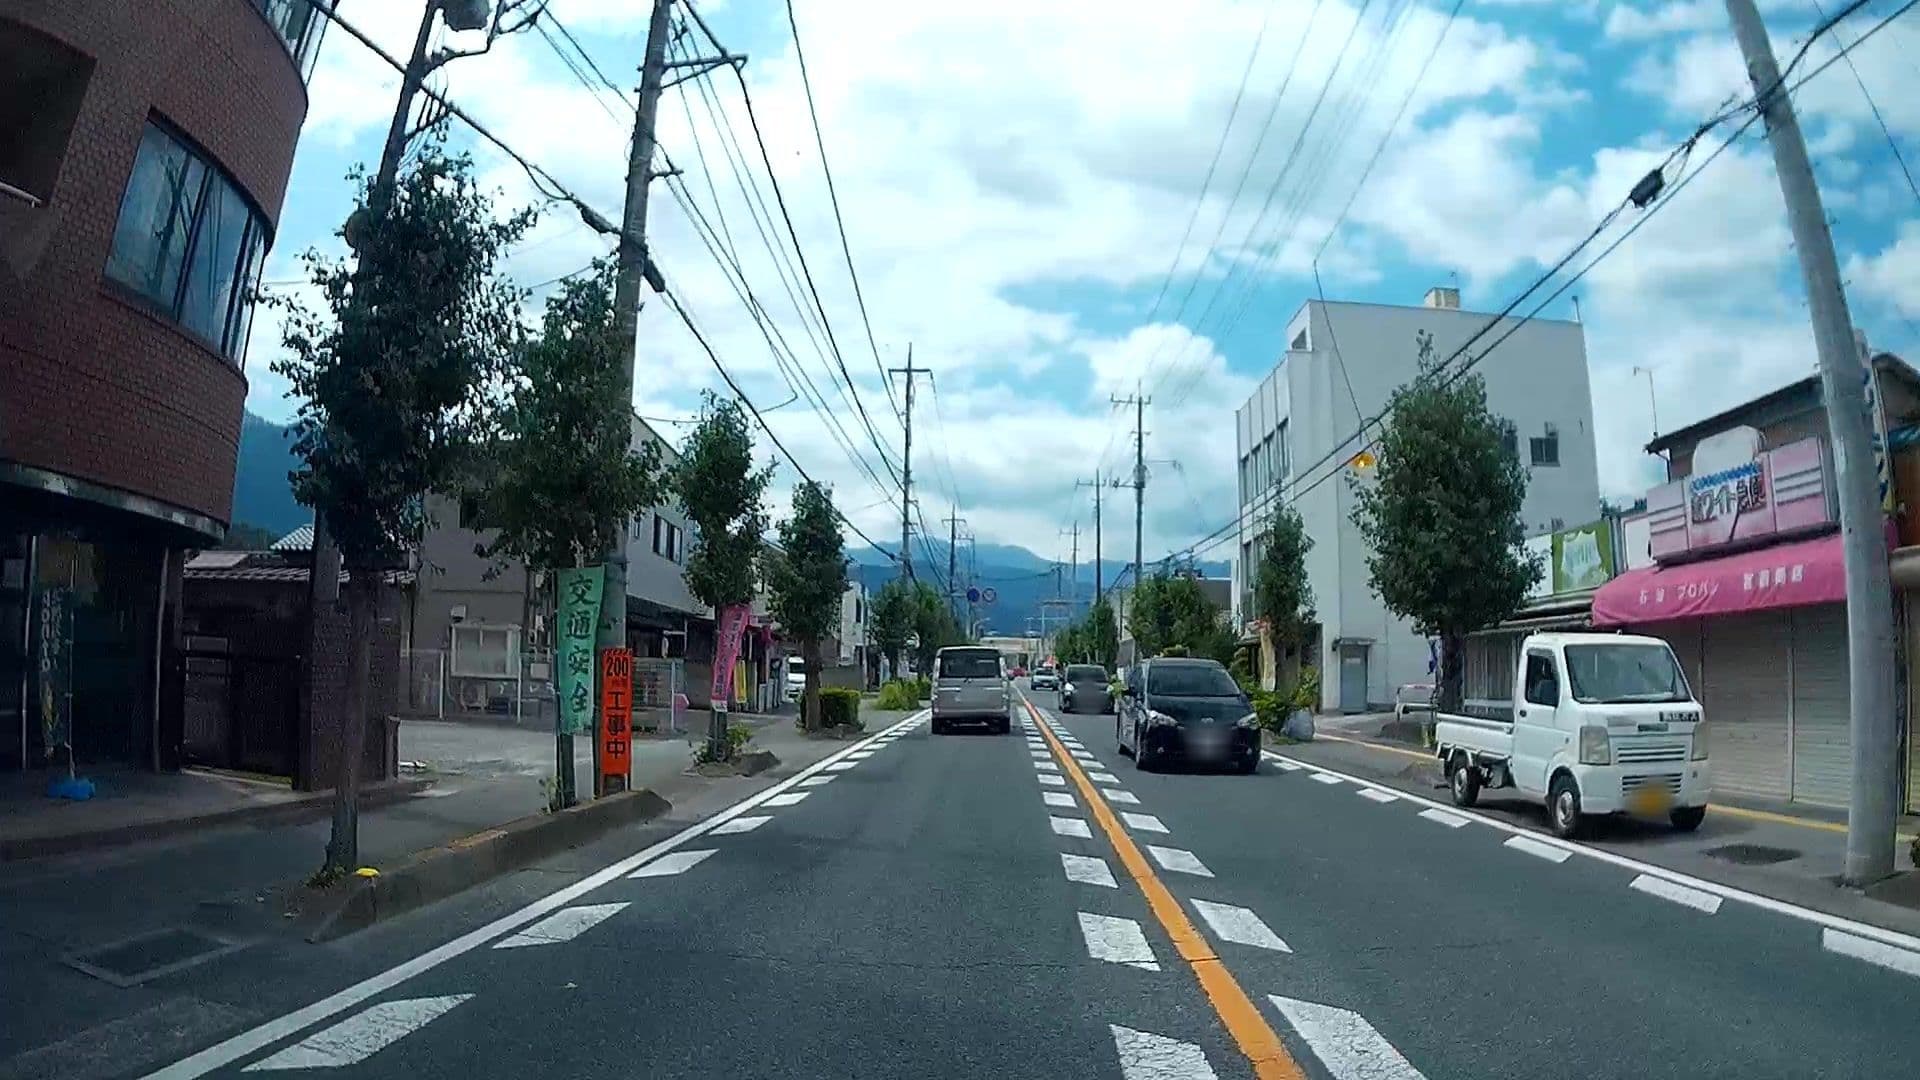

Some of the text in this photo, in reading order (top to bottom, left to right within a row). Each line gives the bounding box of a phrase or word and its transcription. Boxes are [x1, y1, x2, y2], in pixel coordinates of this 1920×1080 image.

[565, 574, 596, 713] 交通安全
[606, 656, 629, 677] 200
[606, 691, 627, 759] 工事中
